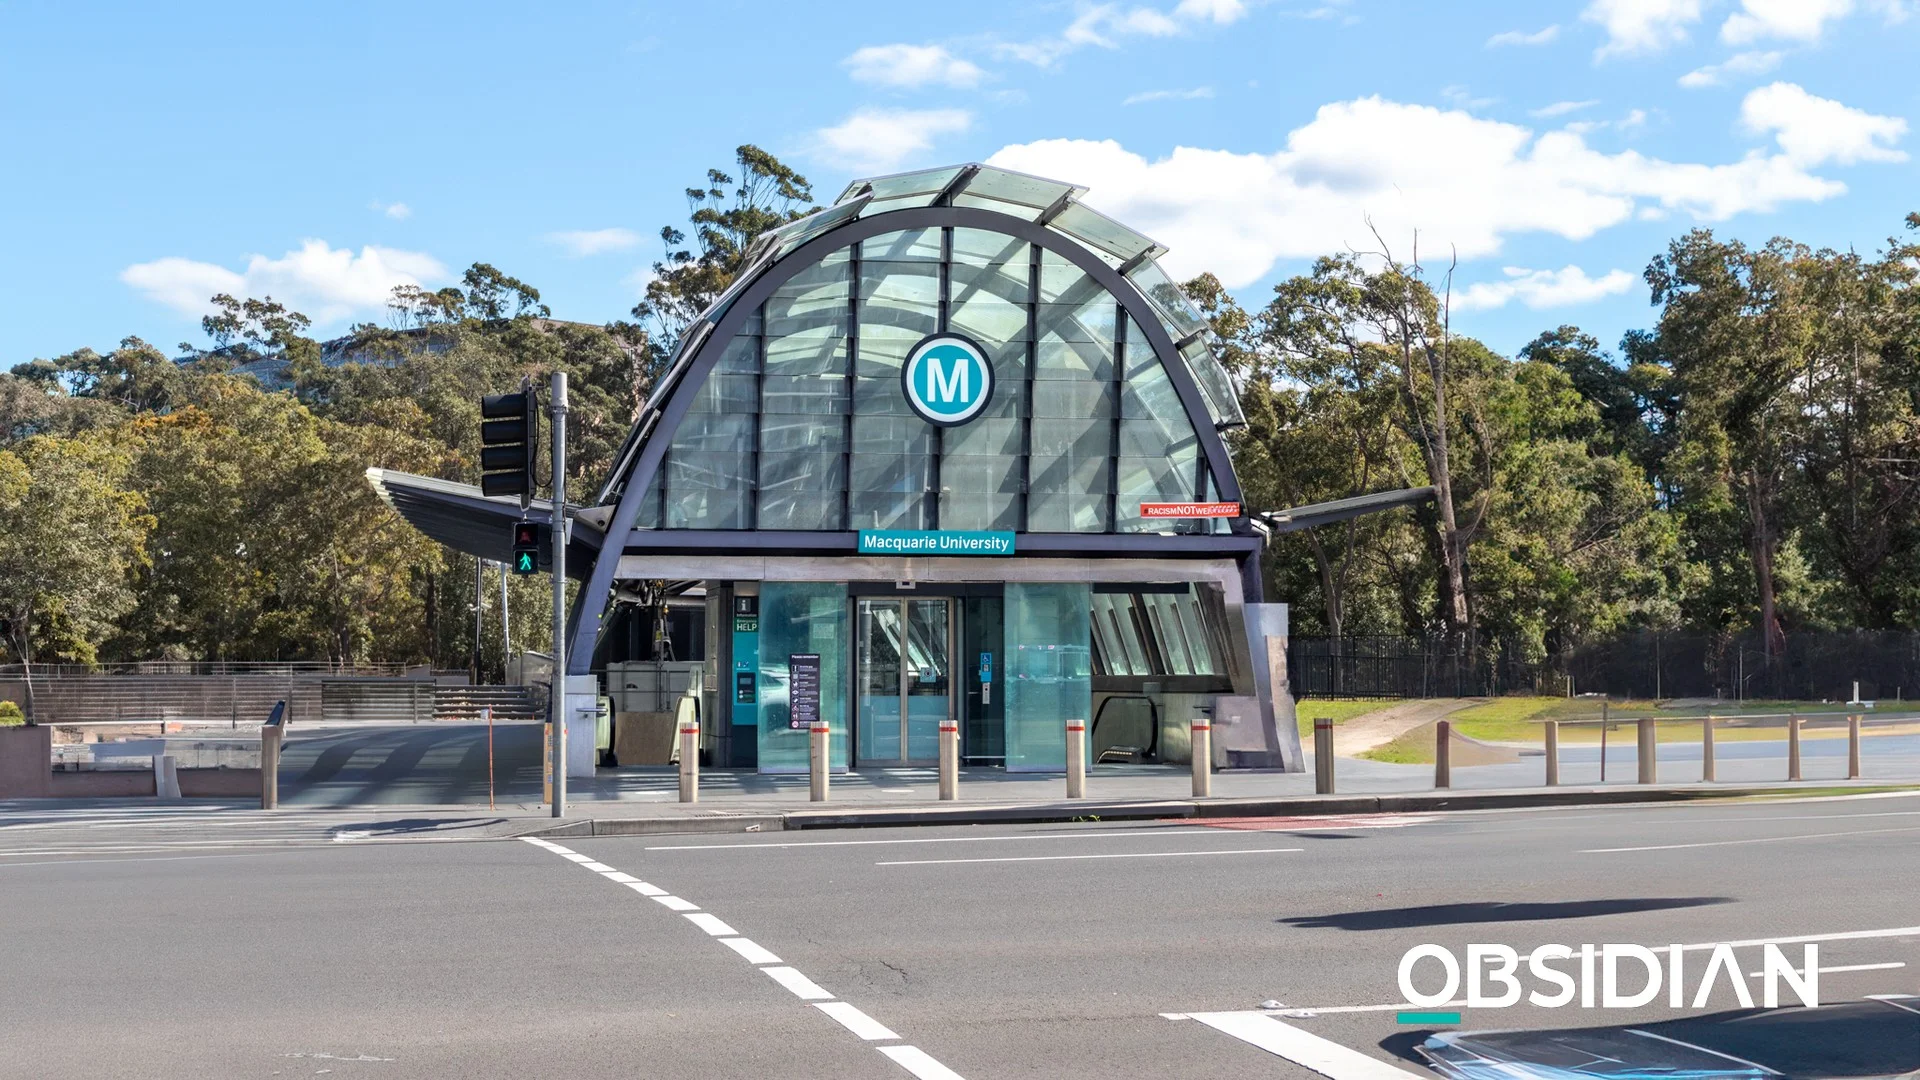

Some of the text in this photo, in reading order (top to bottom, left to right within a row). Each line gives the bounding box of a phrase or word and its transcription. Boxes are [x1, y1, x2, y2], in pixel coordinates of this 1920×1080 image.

[927, 358, 969, 403] M
[864, 535, 1010, 552] Macquarie University
